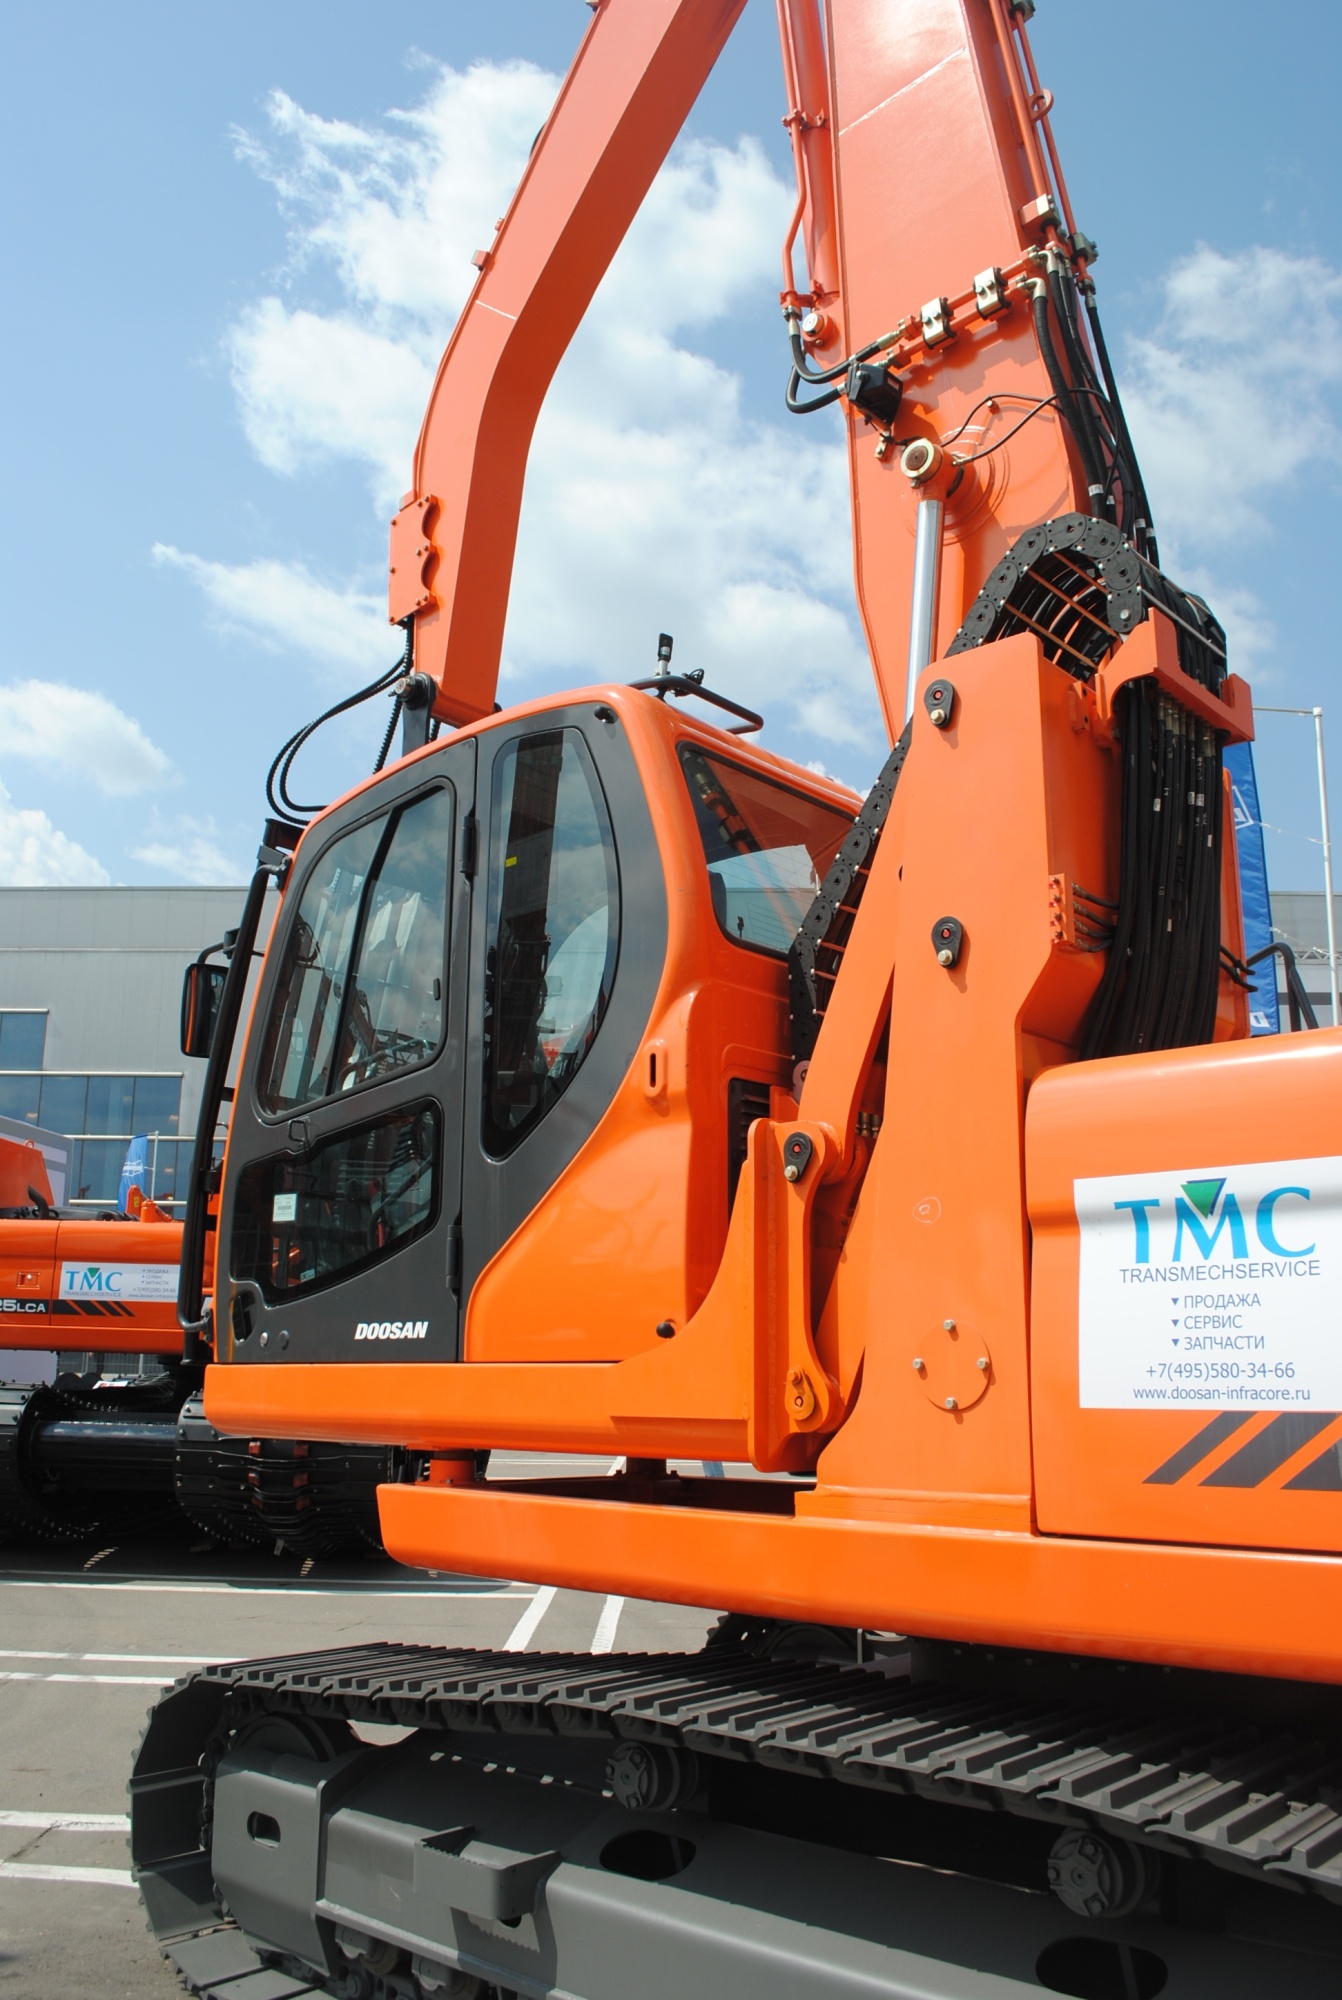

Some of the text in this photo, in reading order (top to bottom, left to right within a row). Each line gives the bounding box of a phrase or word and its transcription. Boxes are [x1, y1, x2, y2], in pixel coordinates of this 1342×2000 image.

[1119, 1260, 1321, 1284] TRANSMECHSERVICE
[0, 1299, 46, 1313] 5LCA
[1184, 1293, 1261, 1311] ПРОДАЖА
[354, 1321, 429, 1340] DOOSAN
[1184, 1315, 1243, 1330] СЕРВИС
[1184, 1335, 1265, 1351] ЗАПЧАСТИ
[1145, 1362, 1296, 1382] +7(495)580-34-66
[1133, 1386, 1311, 1401] www.doosan-infracore.ru
